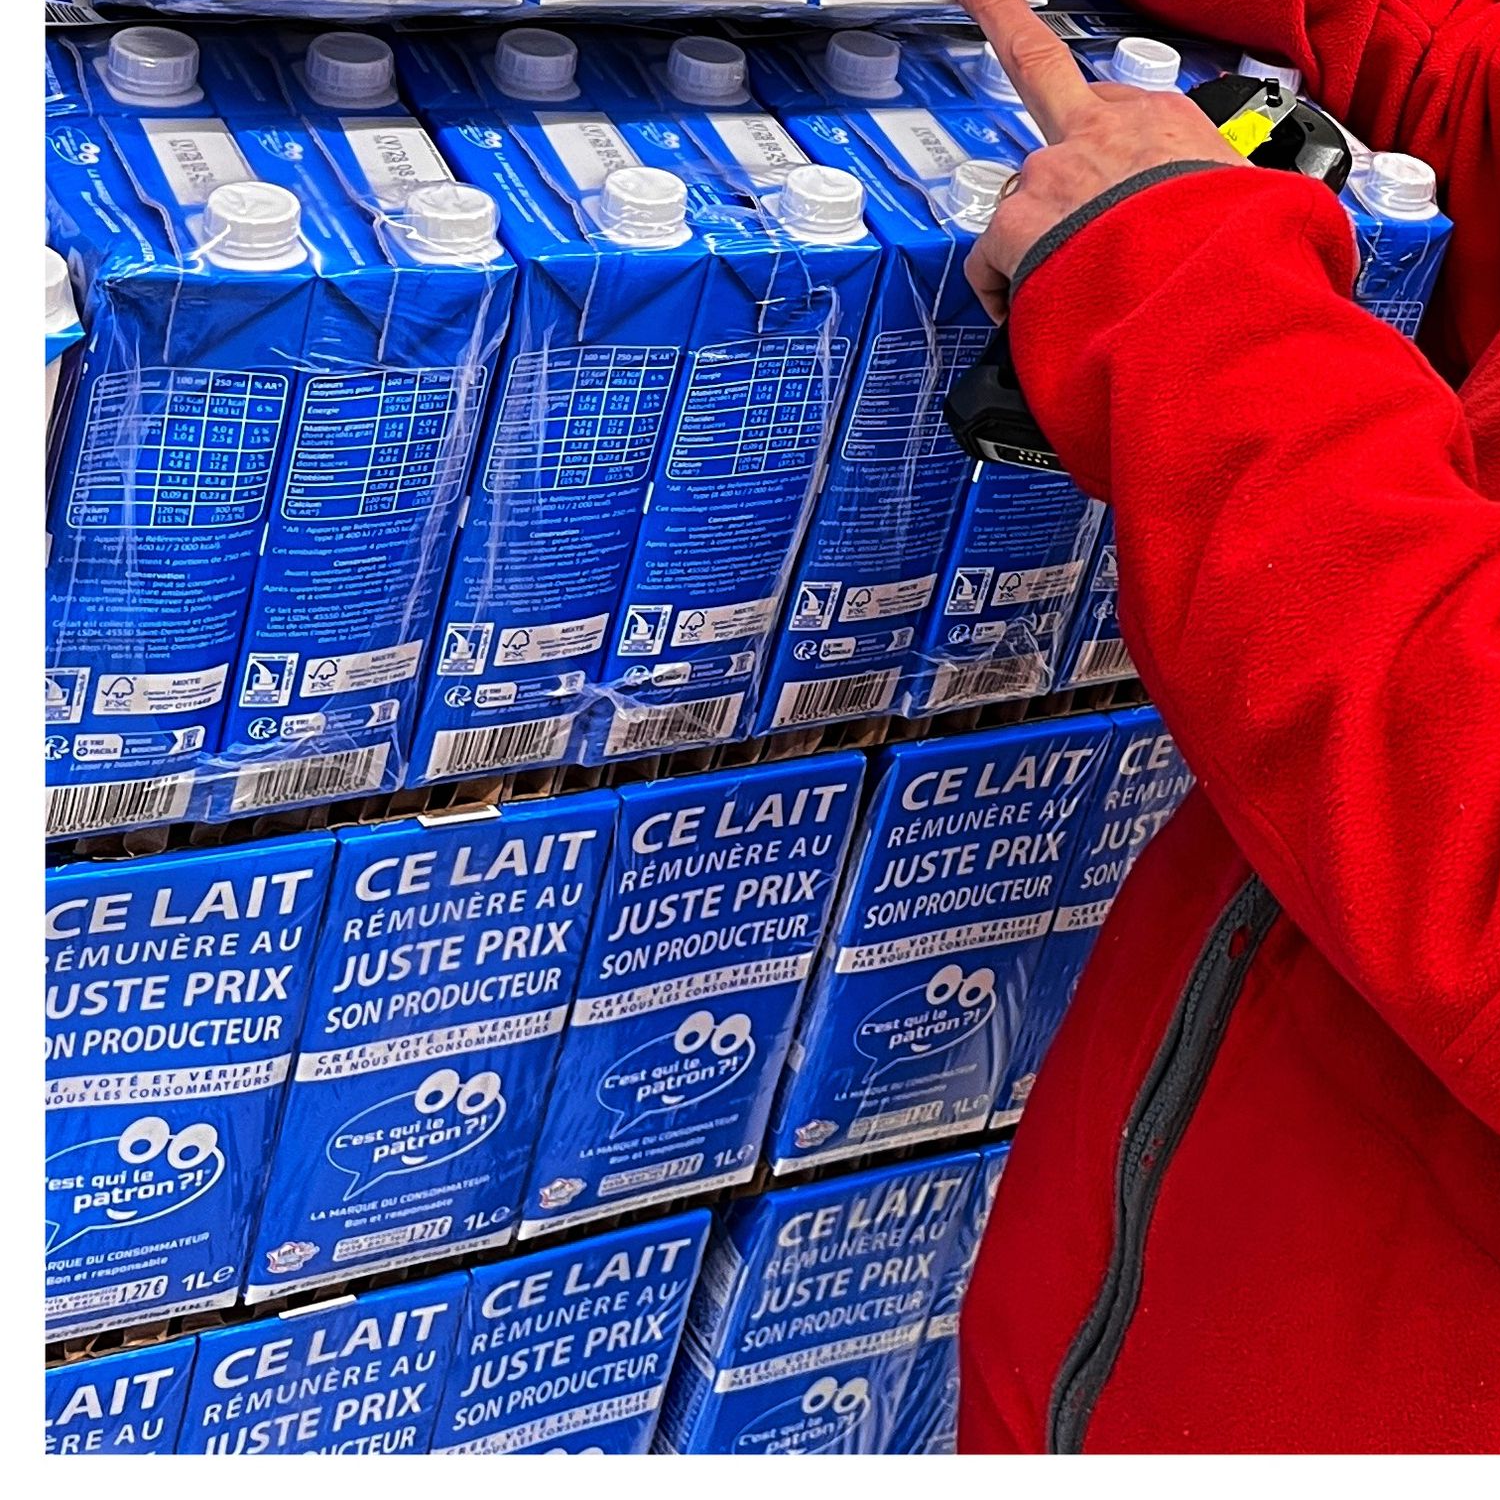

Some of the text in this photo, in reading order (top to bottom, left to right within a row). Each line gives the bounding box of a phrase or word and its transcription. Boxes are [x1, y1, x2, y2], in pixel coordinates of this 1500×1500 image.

[901, 748, 1094, 812] CE LAIT
[631, 783, 848, 855] CE LAIT
[354, 829, 597, 902] CE LAIT
[618, 833, 833, 895] RÉMUNÈRE AU
[45, 869, 314, 941] CE LAIT
[343, 882, 584, 944] RÉMUNÈRE AU
[607, 868, 822, 942] JUSTE PRIX
[249, 925, 303, 955] AU
[332, 919, 573, 994] JUSTE PRIX
[599, 913, 809, 980] SON PRODUCTEUR
[182, 964, 295, 1007] PRIX
[324, 967, 562, 1034] SON PRODUCTEUR
[81, 1014, 284, 1057] PRODUCTEUR
[334, 1117, 445, 1150] C'est qui le
[481, 1238, 692, 1320] CE LAIT
[212, 1302, 449, 1390] CE LAIT
